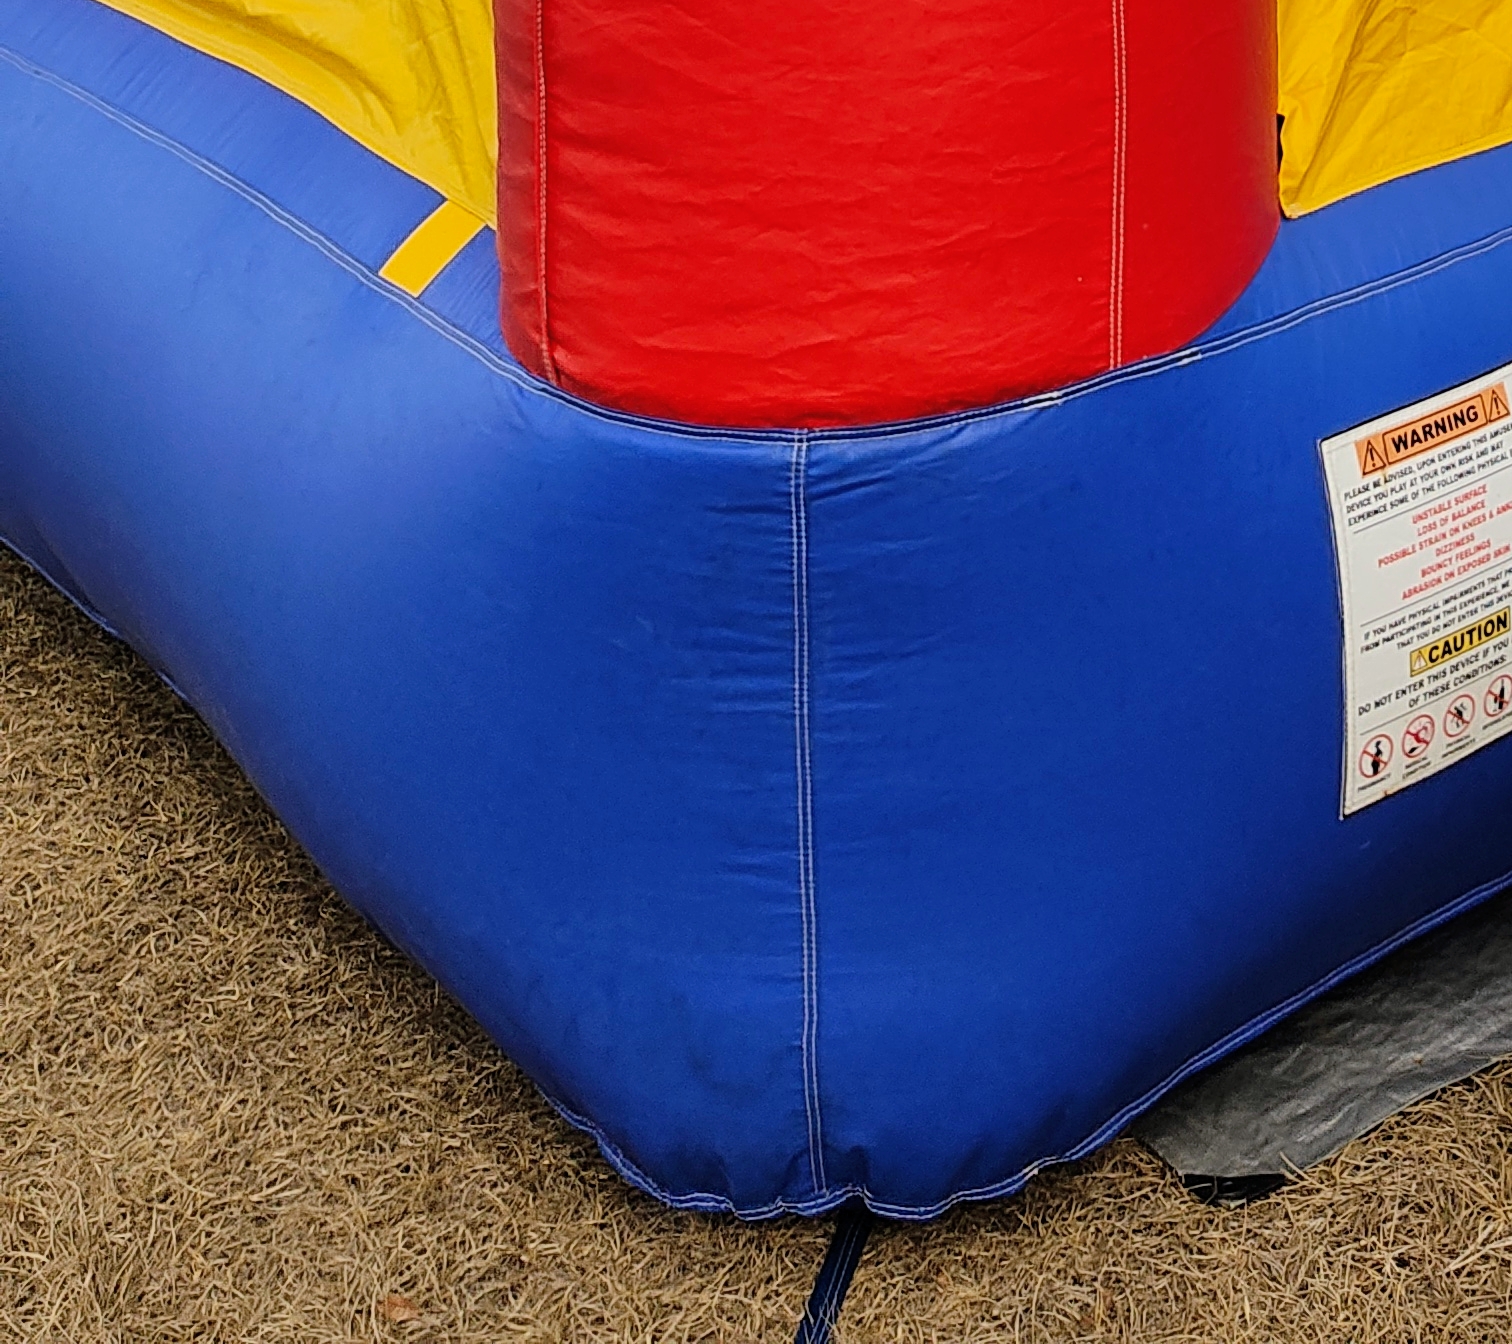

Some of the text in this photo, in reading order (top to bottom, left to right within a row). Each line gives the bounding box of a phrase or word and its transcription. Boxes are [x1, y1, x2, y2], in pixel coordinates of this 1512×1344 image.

[1391, 404, 1479, 454] WARNING
[1344, 482, 1370, 501] PLEASE
[1373, 478, 1381, 488] BE
[1416, 457, 1435, 471] UPON
[1438, 441, 1472, 462] ENTERING
[1472, 433, 1488, 447] THIS
[1346, 440, 1504, 514] DEVICE YOU PLAY AT YOUR OWN RISK AND MAY
[1390, 494, 1409, 510] SOME
[1411, 489, 1420, 500] OF
[1422, 483, 1435, 495] THE
[1437, 465, 1476, 490] FOLLOWING
[1477, 453, 1509, 471] PHYSICAL
[1412, 484, 1488, 524] UNSTABLE SURFACE
[1417, 499, 1486, 536] LOSS OF BALANCE
[1378, 543, 1417, 568] POSSIBLE
[1419, 532, 1447, 550] STRAIN
[1449, 526, 1460, 537] ON
[1462, 513, 1487, 531] KNEES
[1436, 532, 1475, 557] DIZZINESS
[1455, 538, 1491, 562] FEELINGS
[1402, 575, 1442, 600] ABRASION
[1444, 569, 1455, 581] ON
[1457, 553, 1491, 576] EXPOSED
[1372, 624, 1387, 637] YOU
[1389, 616, 1407, 630] HAVE
[1408, 601, 1440, 621] PHYSICAL
[1487, 570, 1503, 585] THAT
[1396, 636, 1414, 650] THAT
[1416, 628, 1429, 642] YOU
[1432, 623, 1441, 634] DO
[1442, 617, 1456, 629] NOT
[1457, 606, 1478, 623] ENTER
[1360, 639, 1380, 654] FROM
[1382, 616, 1432, 644] PARTICIPATING
[1434, 612, 1441, 622] IN
[1442, 604, 1457, 617] THIS
[1428, 611, 1508, 664] CAUTION
[1358, 702, 1371, 716] DO
[1374, 693, 1393, 709] NOT
[1395, 679, 1425, 700] ENTER
[1426, 667, 1447, 685] THIS
[1449, 652, 1480, 675] DEVICE
[1482, 646, 1490, 658] IF
[1492, 637, 1509, 651] YOU
[1408, 696, 1420, 708] OF
[1422, 681, 1451, 702] THESE
